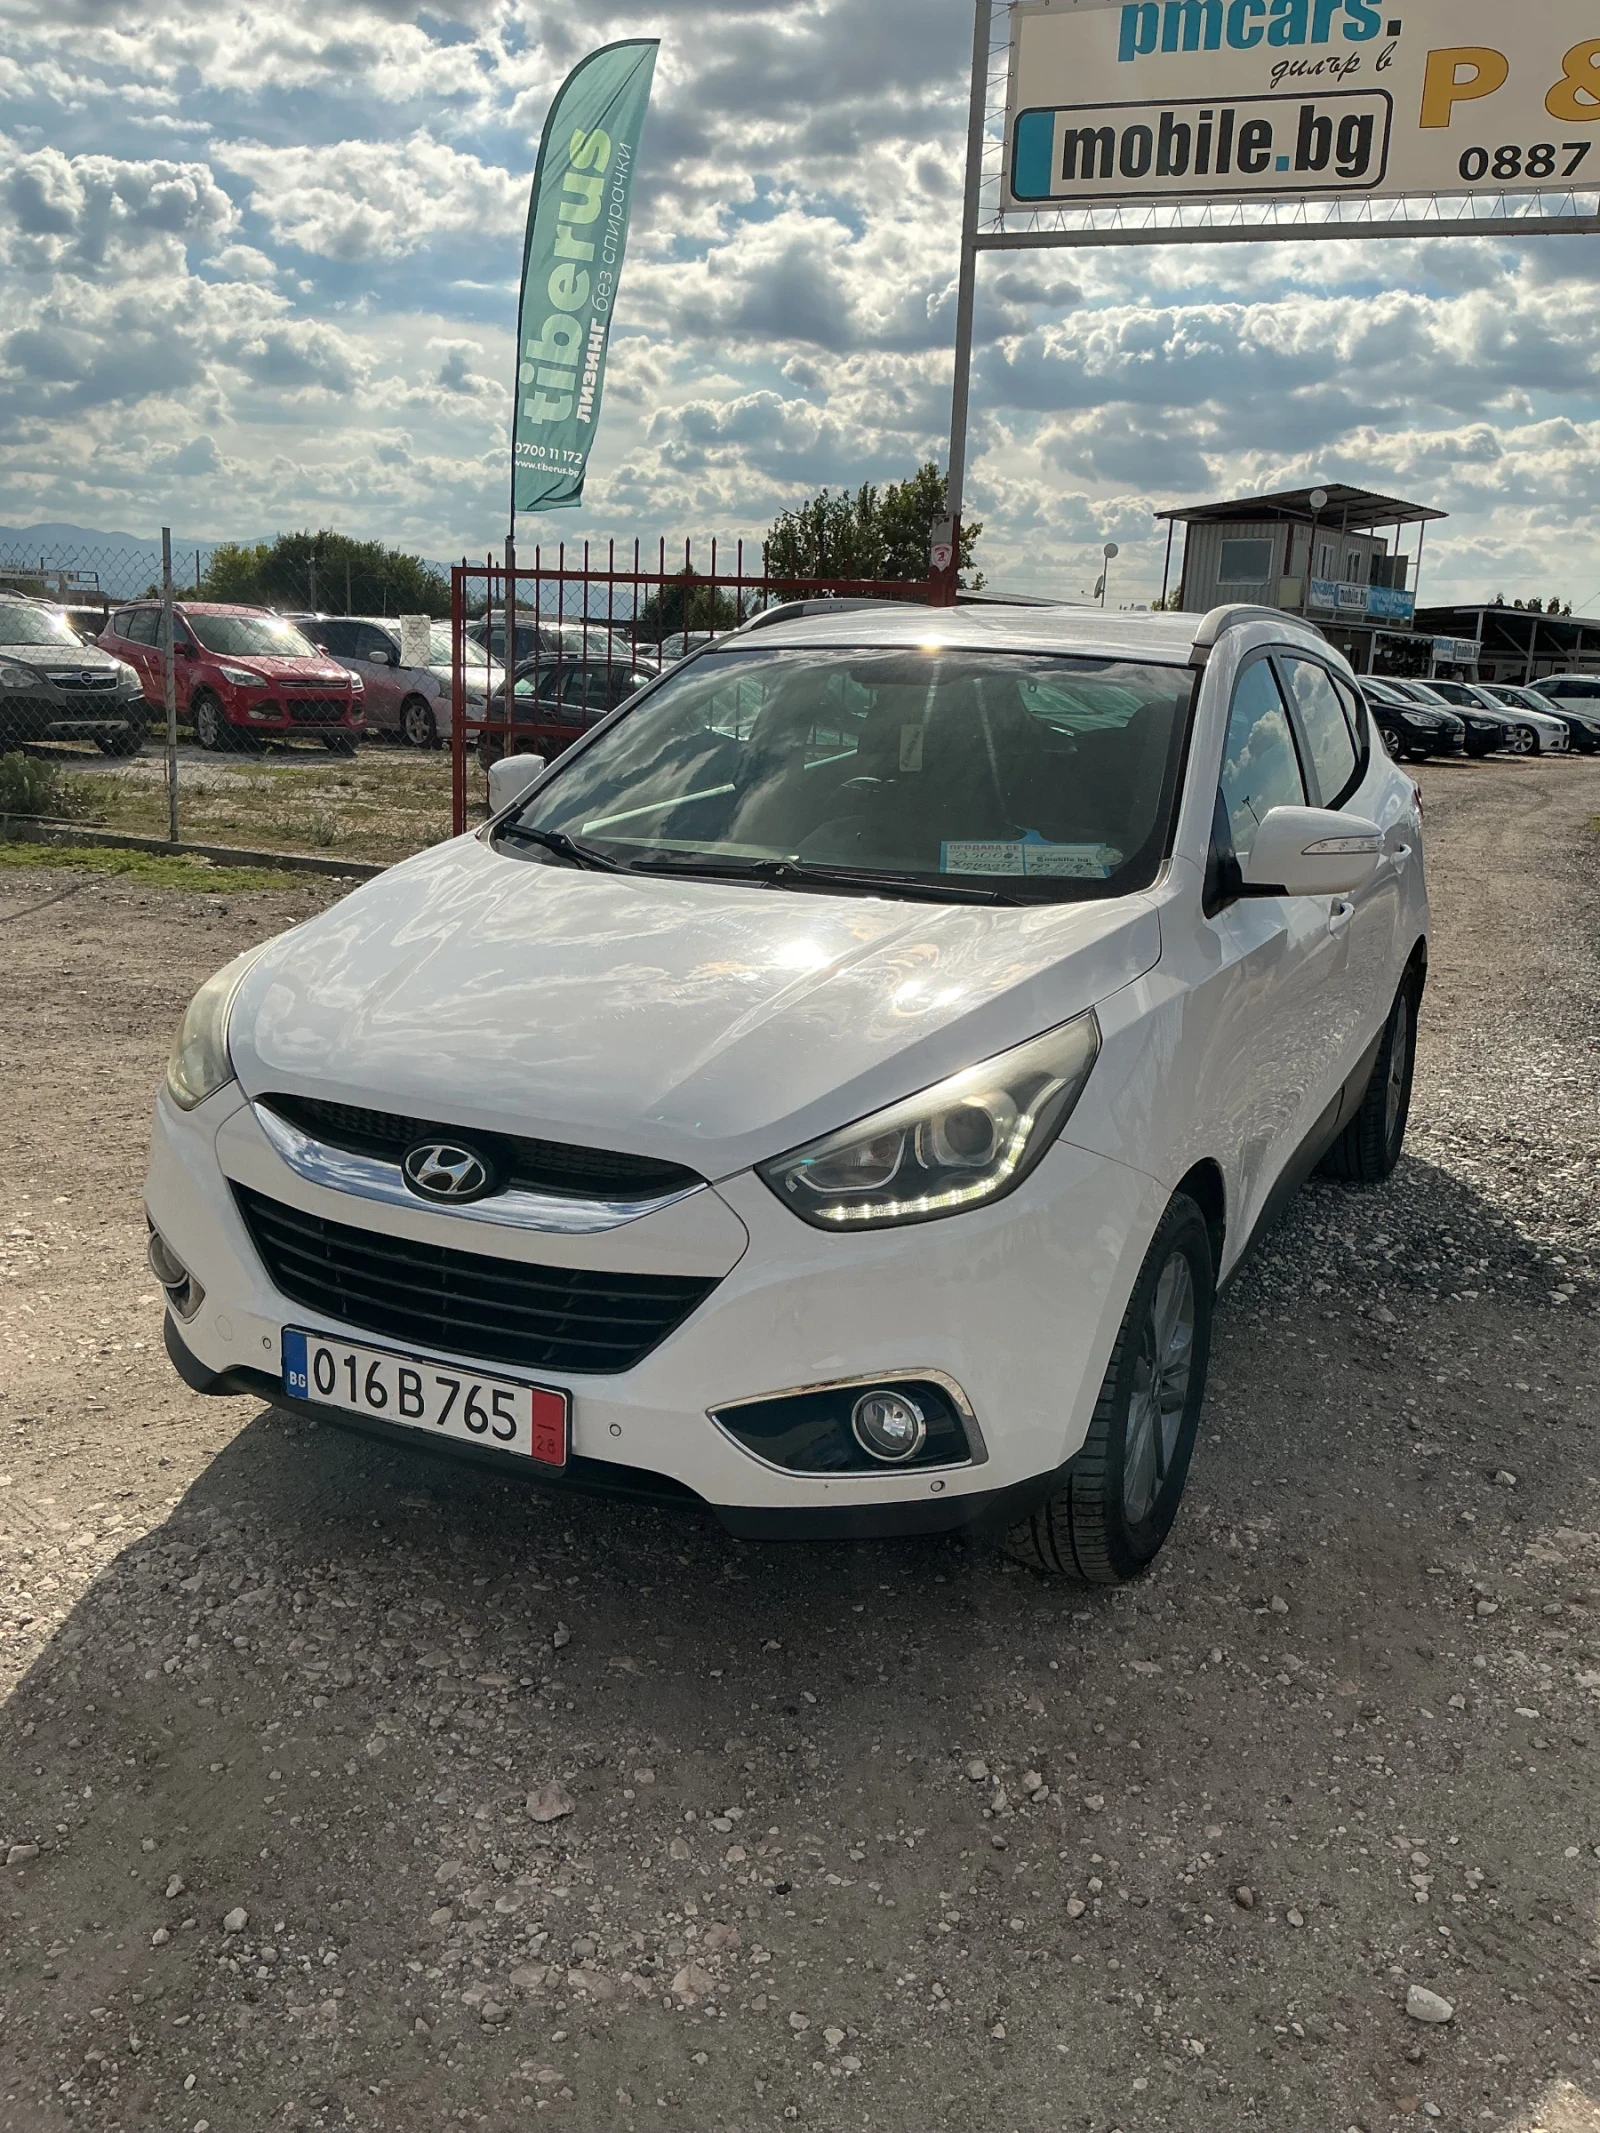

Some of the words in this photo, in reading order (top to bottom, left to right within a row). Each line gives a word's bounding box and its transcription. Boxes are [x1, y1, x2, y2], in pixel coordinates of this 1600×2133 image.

[1270, 51, 1361, 89] дилър
[1375, 41, 1398, 72] в
[1419, 47, 1509, 128] P
[1061, 105, 1374, 181] mobile.bg
[1458, 142, 1591, 181] 0887
[602, 142, 632, 265] спирачки
[518, 128, 612, 425] tiberus
[591, 270, 614, 312] без
[576, 317, 606, 424] лизинг
[515, 442, 546, 458] 0700
[550, 447, 559, 460] 11
[563, 450, 583, 465] 172
[288, 1370, 307, 1389] BG
